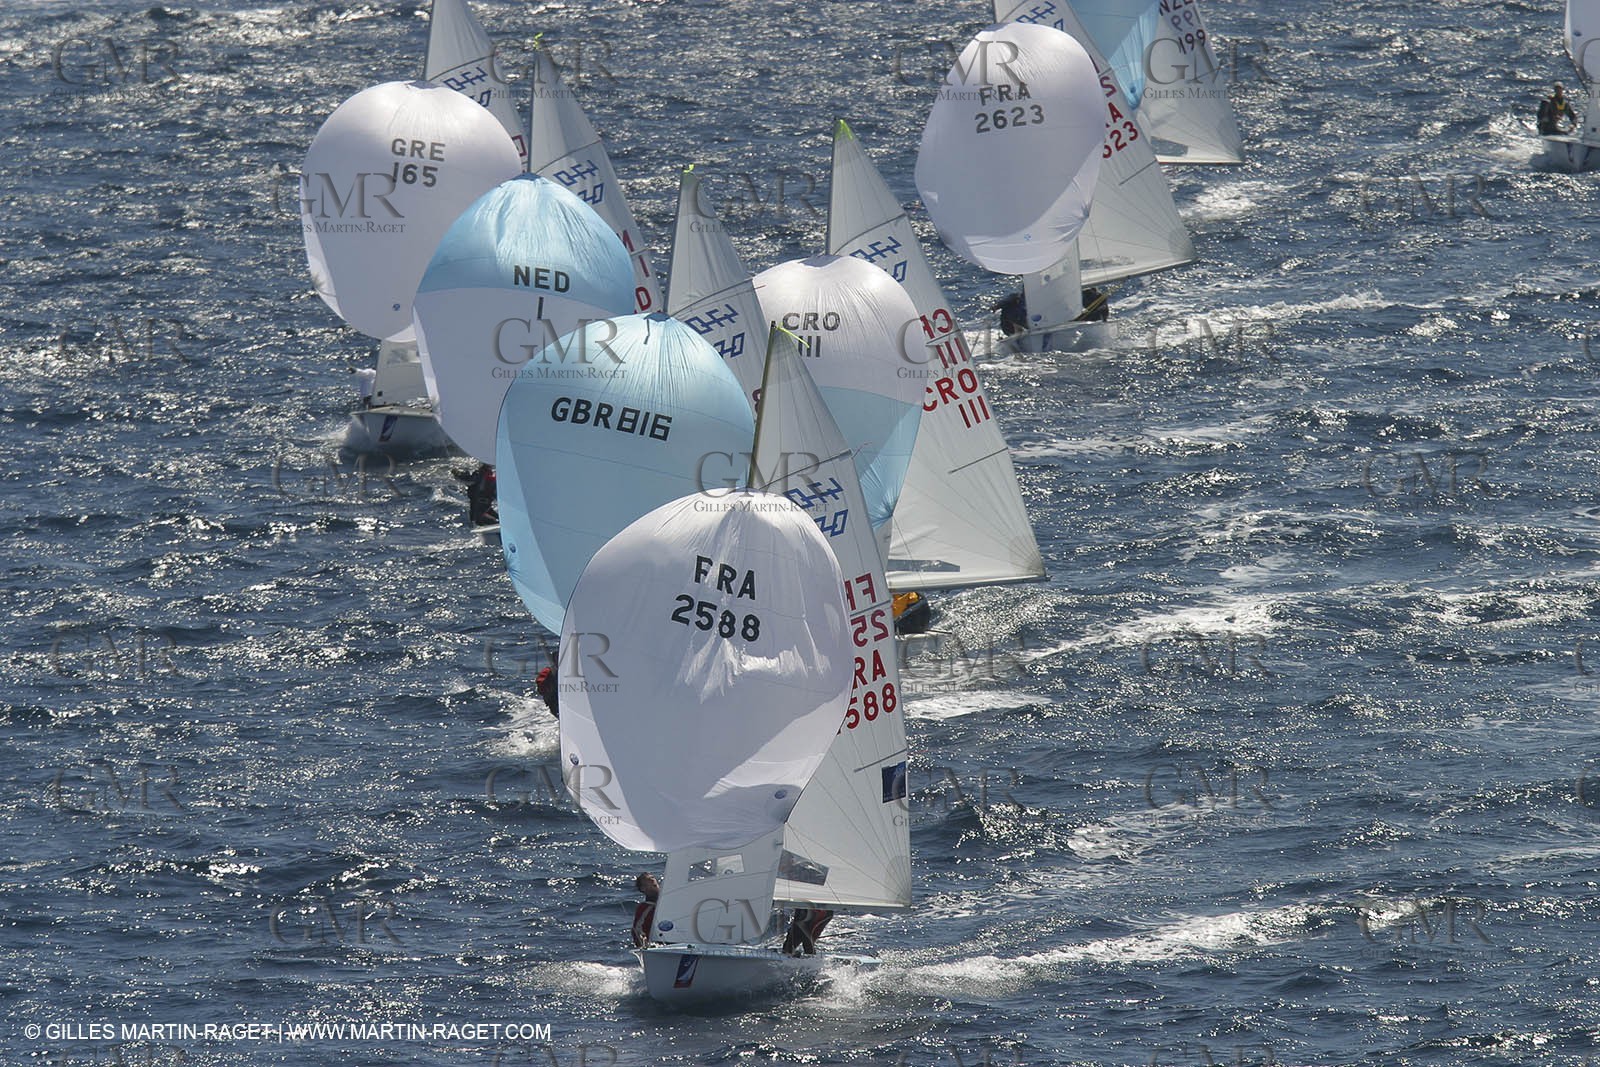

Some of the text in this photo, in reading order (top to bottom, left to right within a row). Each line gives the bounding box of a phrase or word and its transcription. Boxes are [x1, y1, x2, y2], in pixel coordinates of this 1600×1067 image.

[1178, 29, 1206, 54] 199
[979, 84, 1032, 107] FRA
[974, 104, 1045, 134] 2623
[391, 138, 446, 162] GRE
[391, 162, 439, 188] 165
[513, 265, 570, 293] NED
[782, 311, 841, 331] CRO
[922, 368, 978, 412] CRO
[694, 555, 757, 601] FRA
[671, 594, 761, 642] 2588
[853, 649, 887, 689] RA
[845, 682, 897, 729] 588
